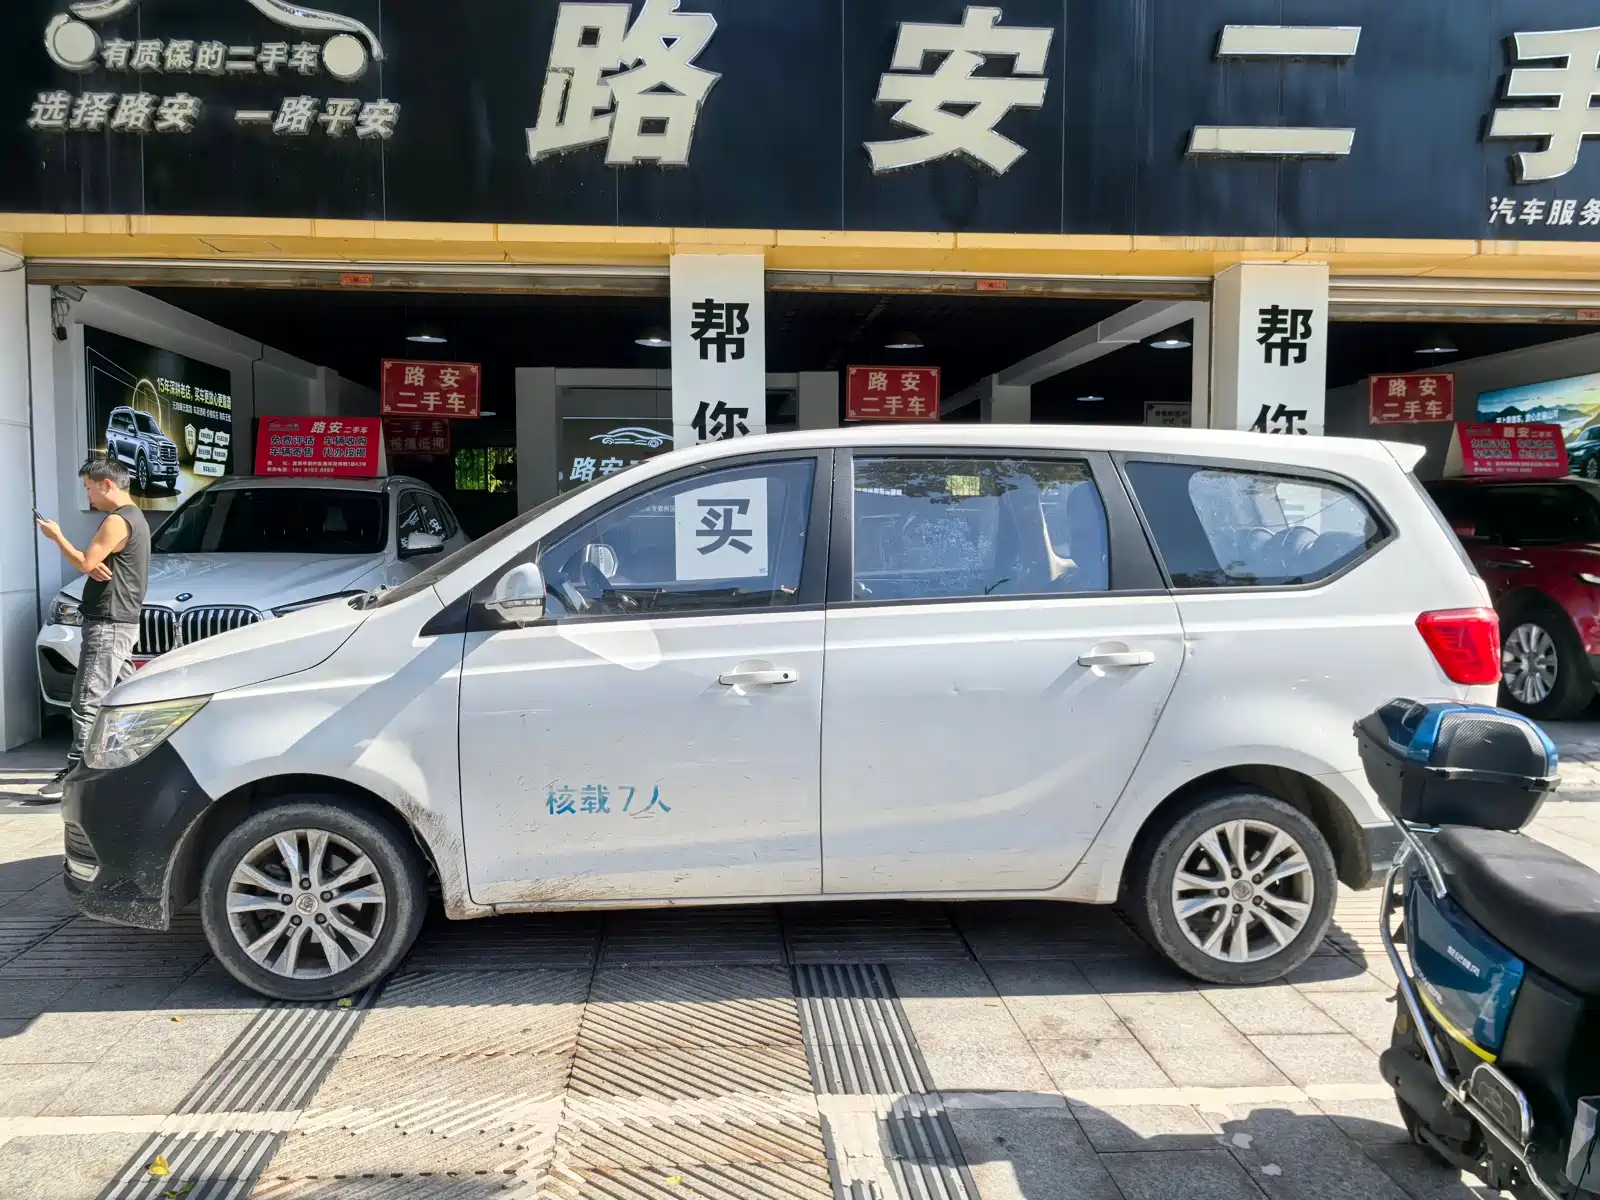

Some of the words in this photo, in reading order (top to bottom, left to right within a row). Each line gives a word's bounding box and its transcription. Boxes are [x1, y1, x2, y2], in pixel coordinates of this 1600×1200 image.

[102, 38, 321, 75] 有质保的二手车
[29, 90, 201, 133] 选择路安
[234, 95, 401, 140] 一路平安
[1488, 196, 1600, 226] 汽车服务
[404, 366, 461, 389] 路安
[868, 372, 920, 392] 路安
[1388, 378, 1437, 397] 路安
[397, 392, 466, 412] 二手车
[861, 396, 926, 415] 二手车
[1382, 400, 1443, 419] 二手车
[570, 457, 640, 481] 路安
[545, 784, 672, 815] 核载7人
